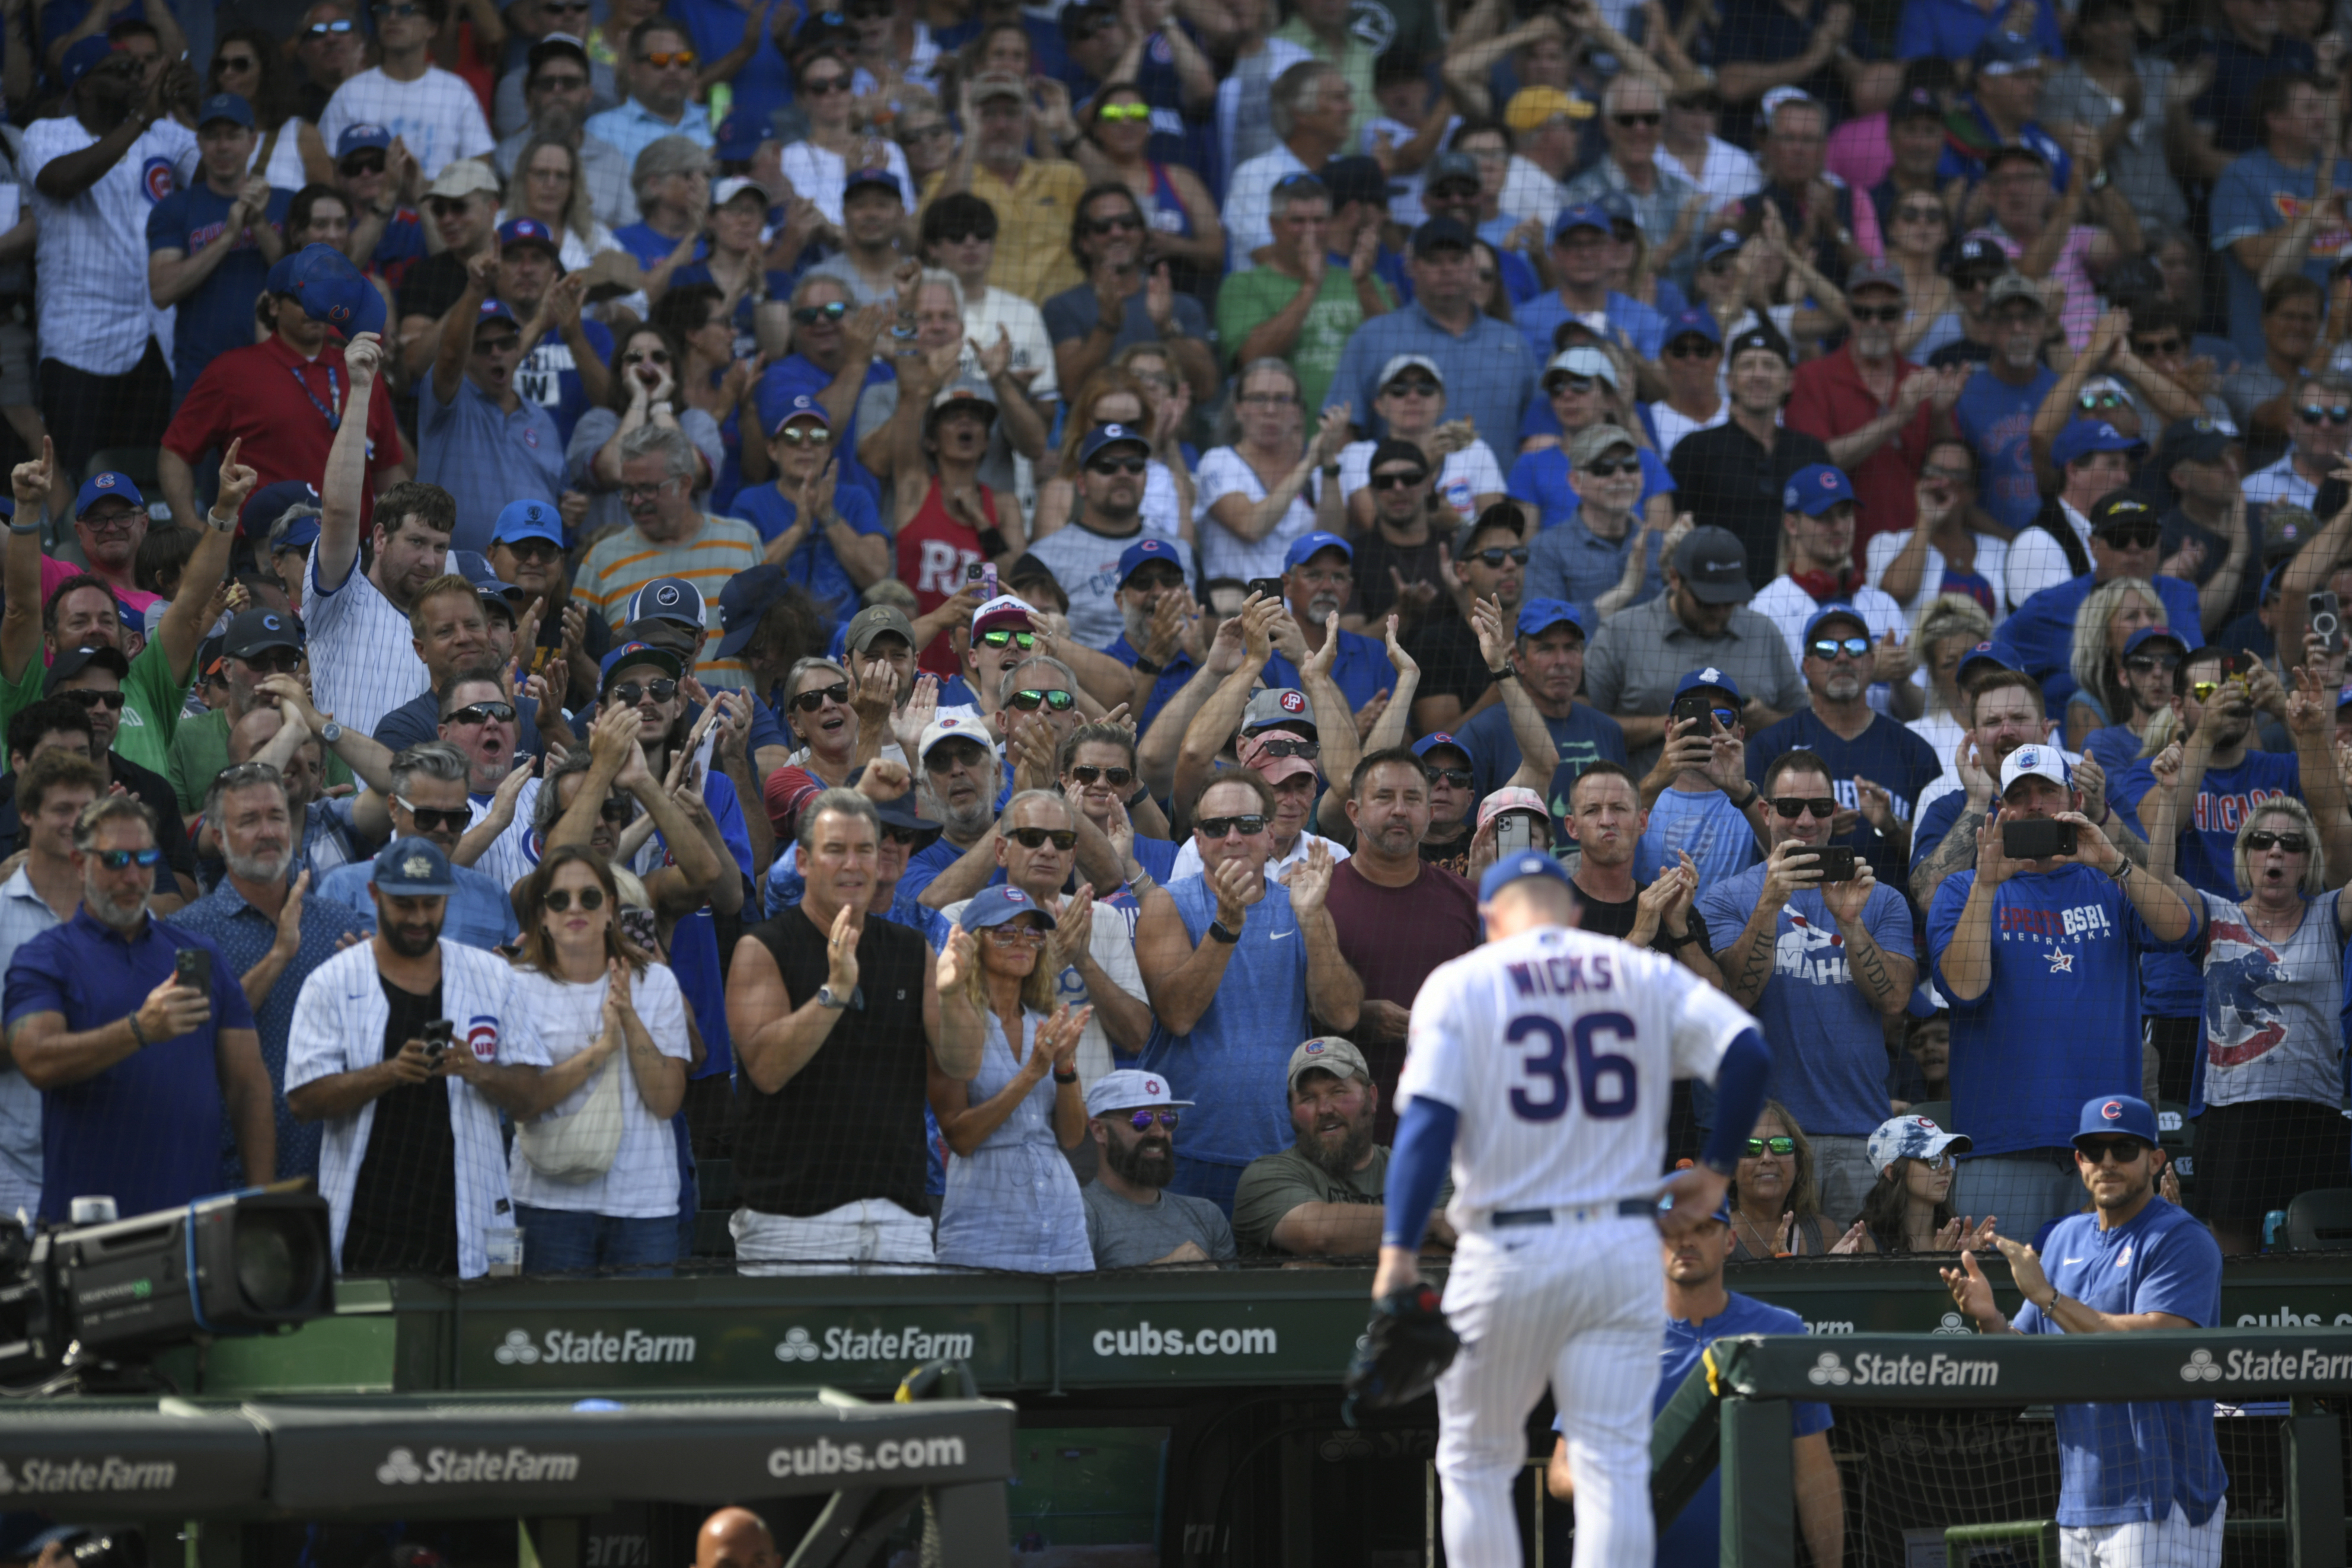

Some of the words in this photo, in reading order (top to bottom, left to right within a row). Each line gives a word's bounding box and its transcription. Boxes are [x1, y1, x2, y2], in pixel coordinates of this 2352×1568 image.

[2003, 929, 2111, 945] NEBRASKA
[1507, 956, 1612, 997] WICKS
[1506, 1011, 1639, 1123] 36
[2102, 1101, 2123, 1119] C
[1092, 1322, 1277, 1356] cubs.com
[768, 1436, 966, 1477] cubs.com
